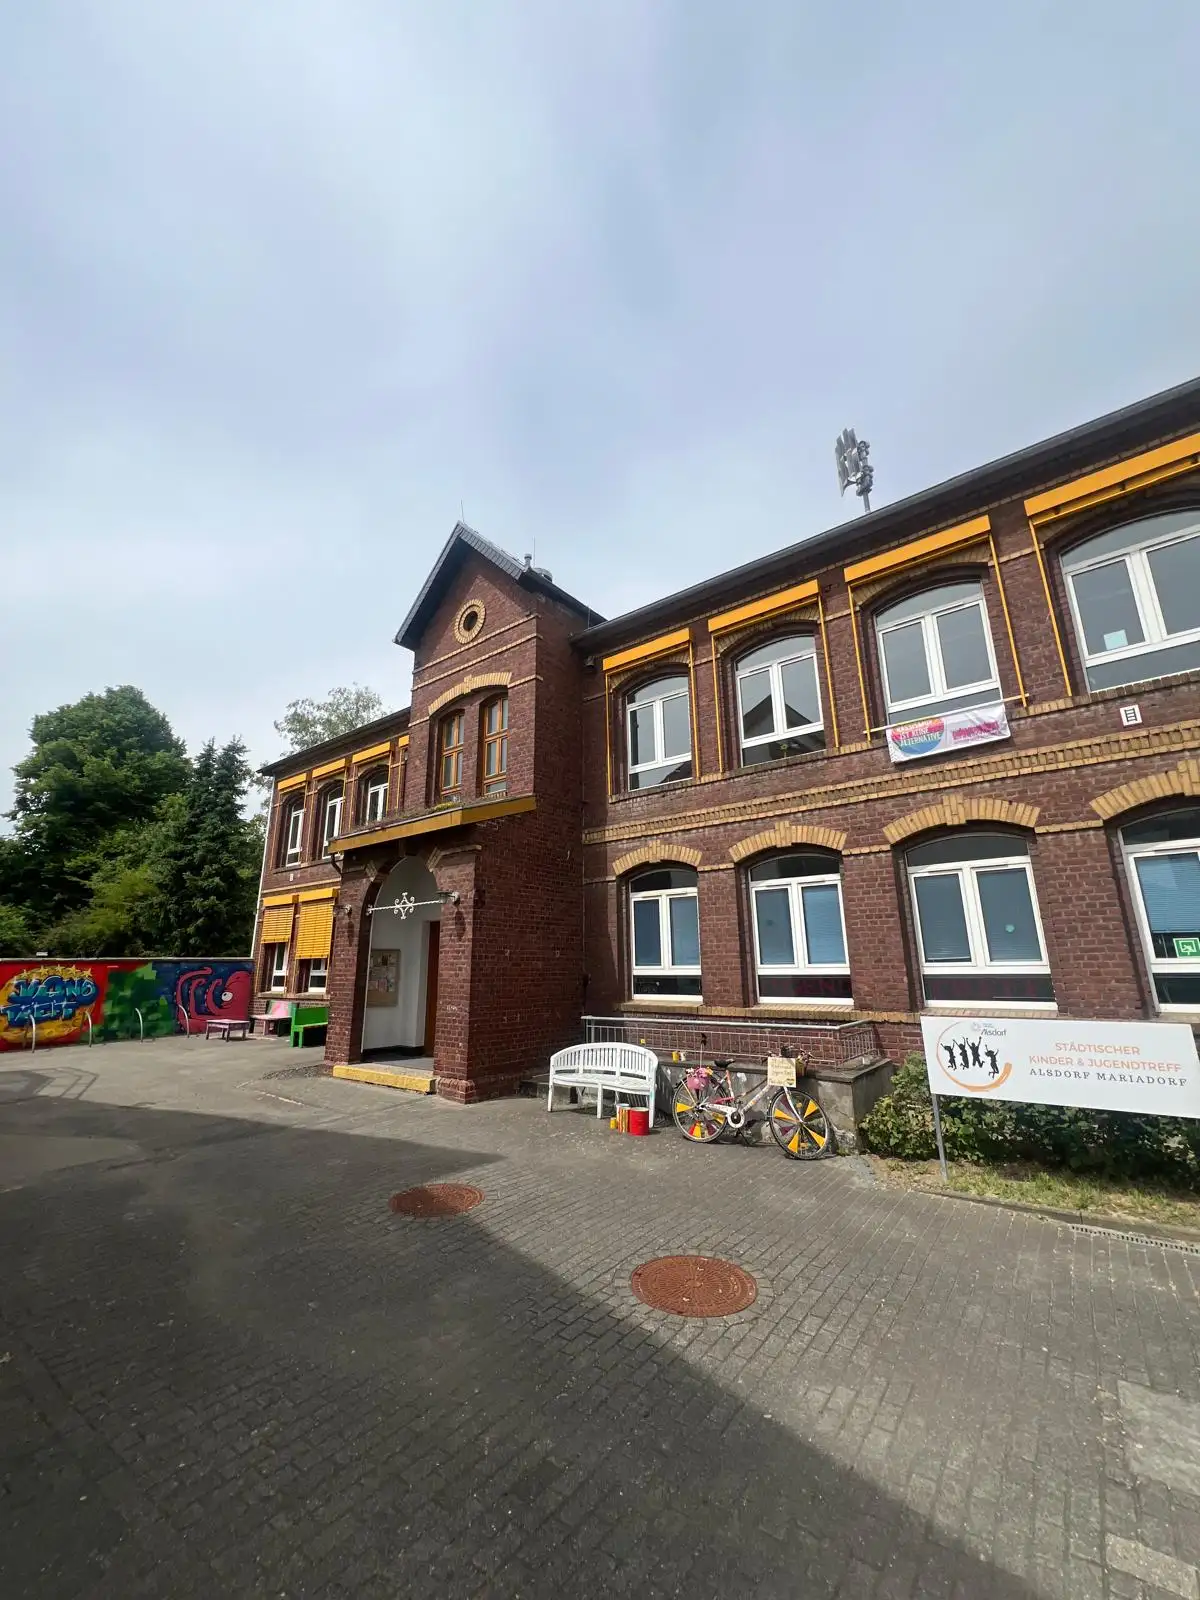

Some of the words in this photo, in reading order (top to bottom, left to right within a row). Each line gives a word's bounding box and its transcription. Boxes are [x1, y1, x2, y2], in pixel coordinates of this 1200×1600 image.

[900, 732, 941, 746] ALTERNATIVE
[1055, 1041, 1140, 1055] STÄDTISCHER
[1029, 1055, 1074, 1066] KINDER
[1077, 1057, 1085, 1066] &
[1087, 1058, 1182, 1072] JUGENDTREFF
[1029, 1068, 1090, 1079] ALSDORF
[1096, 1072, 1187, 1087] MARIADORF
